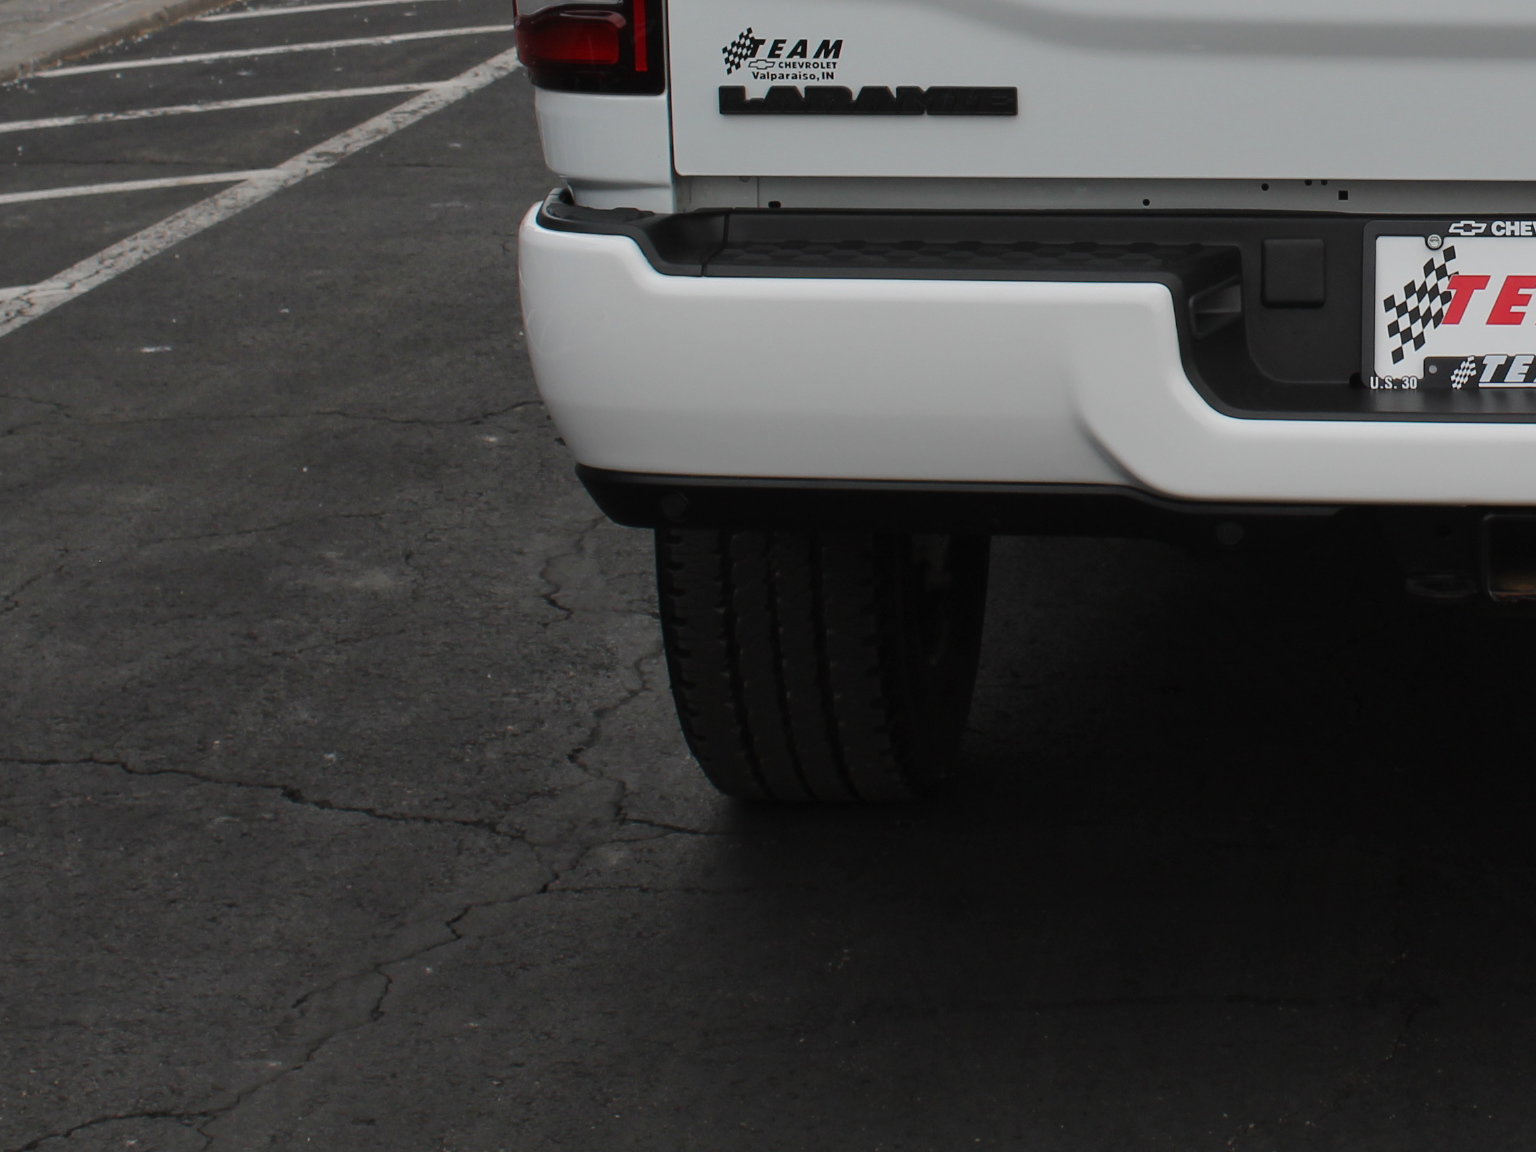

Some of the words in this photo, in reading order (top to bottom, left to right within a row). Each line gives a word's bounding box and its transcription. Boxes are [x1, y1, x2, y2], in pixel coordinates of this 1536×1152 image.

[750, 38, 843, 59] TEAM
[778, 61, 838, 70] CHEVROLET
[1370, 376, 1397, 390] U.S.
[1401, 376, 1418, 390] 30
